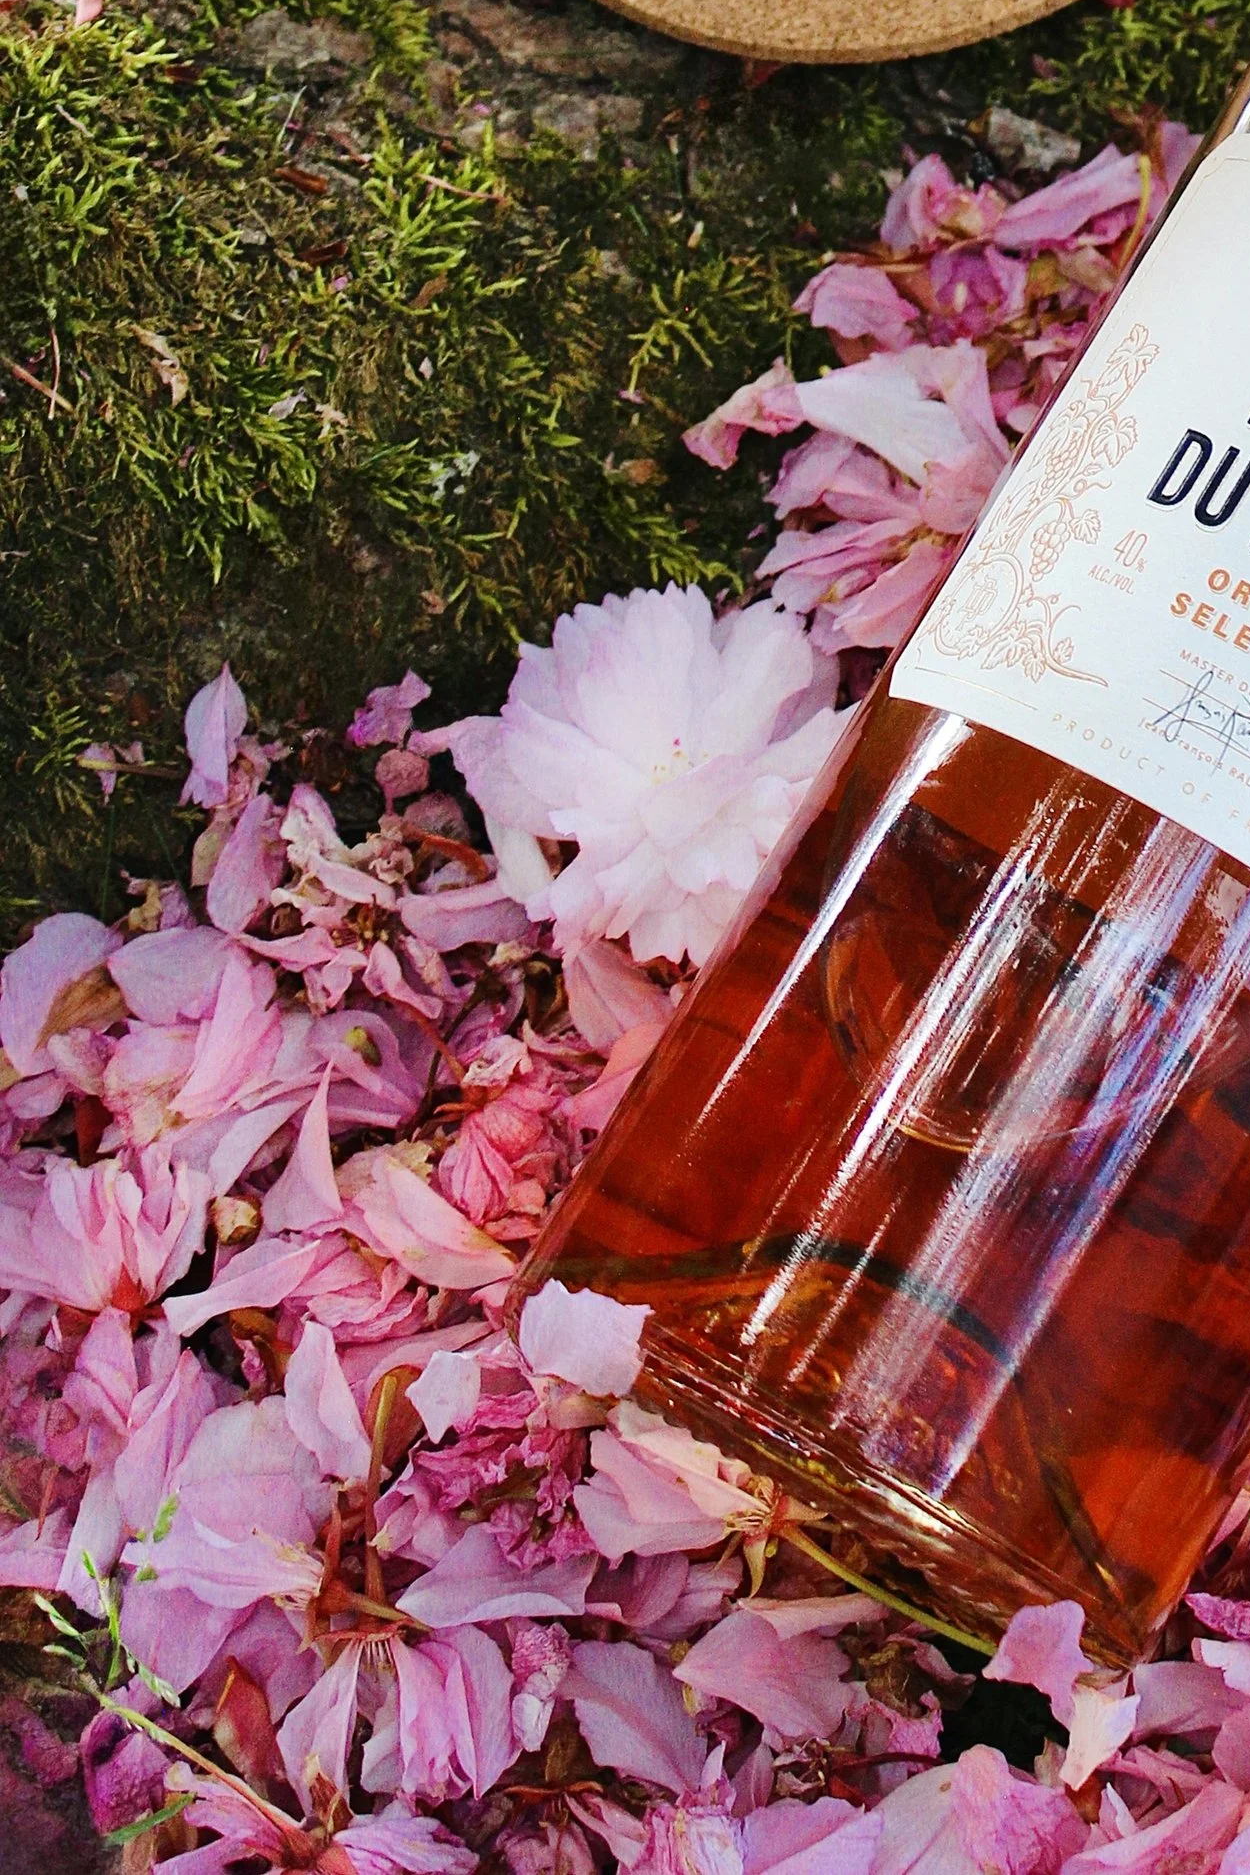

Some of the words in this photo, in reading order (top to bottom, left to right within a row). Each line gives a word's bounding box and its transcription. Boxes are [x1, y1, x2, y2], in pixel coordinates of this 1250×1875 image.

[1179, 649, 1234, 685] MASTER
[1051, 714, 1166, 776] PRODUCT
[1182, 781, 1211, 805] OF
